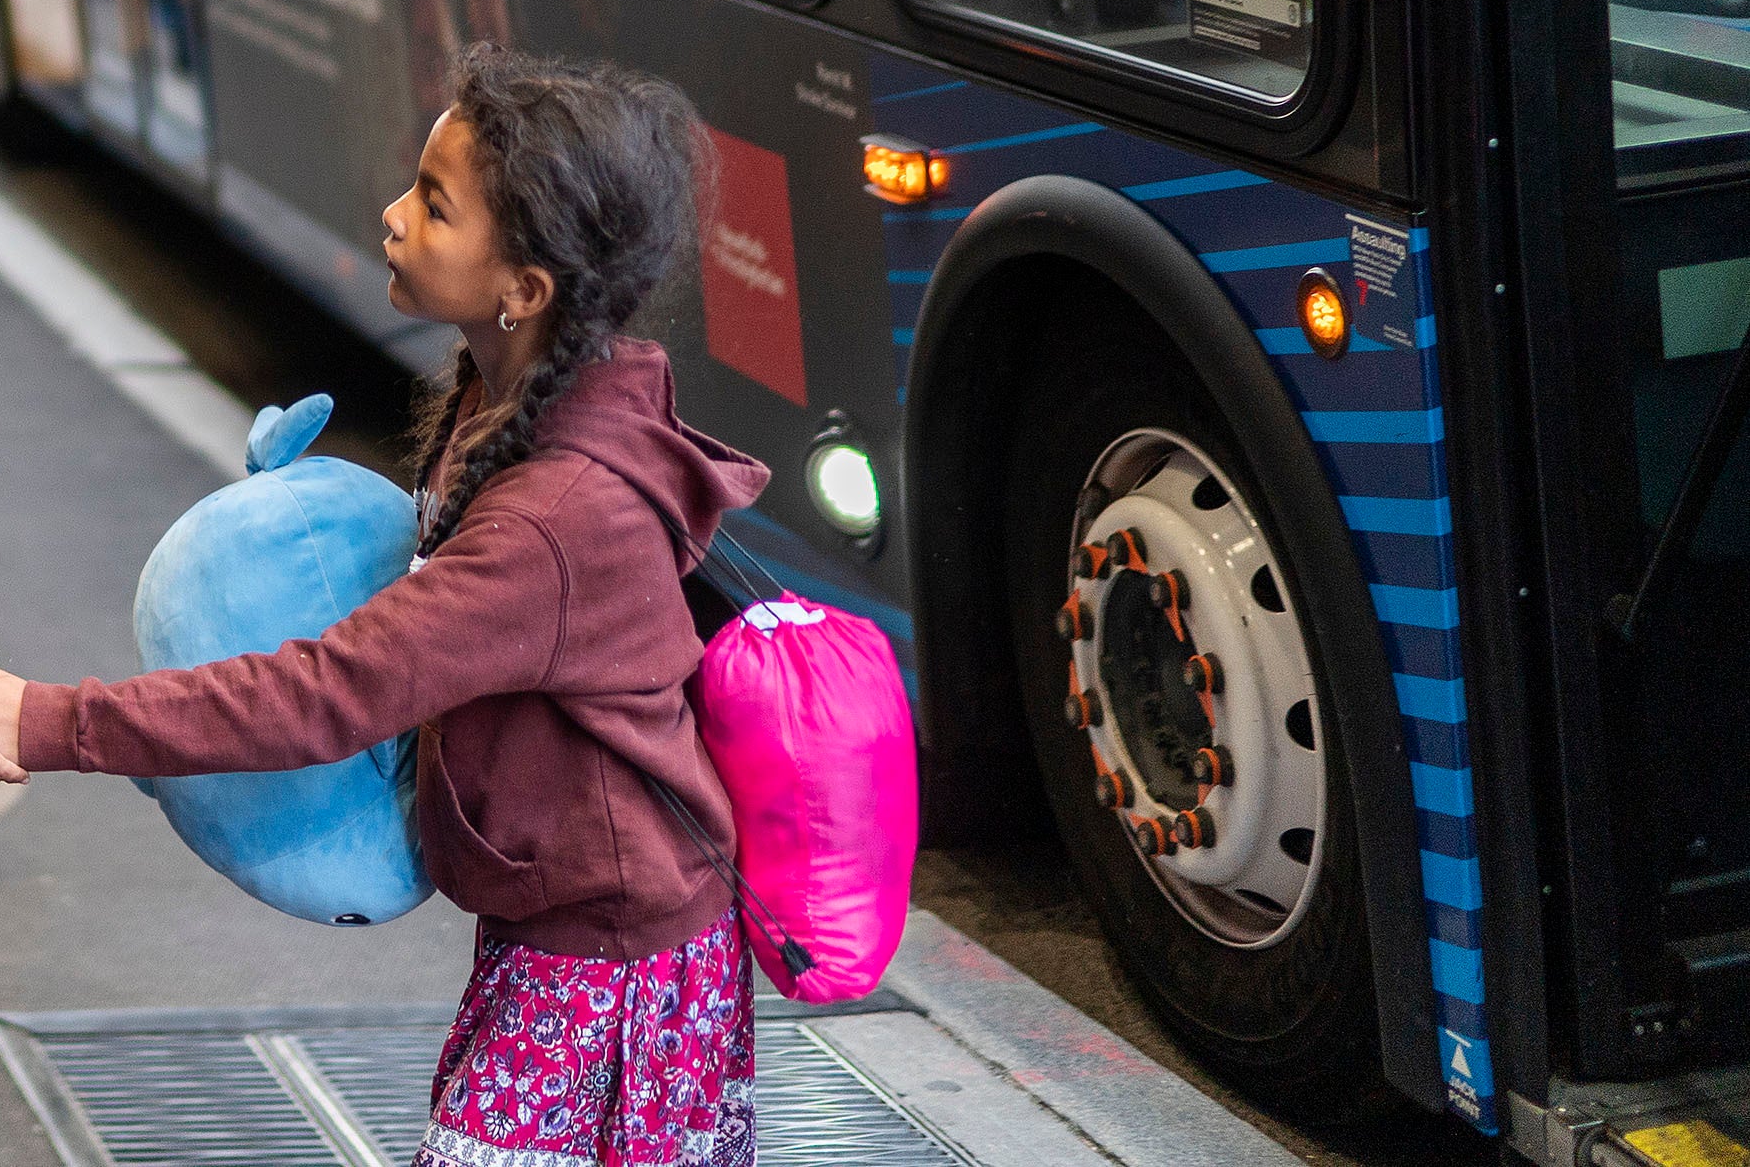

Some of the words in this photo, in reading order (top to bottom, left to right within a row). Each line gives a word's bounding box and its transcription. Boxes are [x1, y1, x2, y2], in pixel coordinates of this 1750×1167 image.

[1351, 224, 1407, 261] Assaulting
[1449, 1075, 1478, 1102] JACK
[1448, 1089, 1481, 1120] POINT
